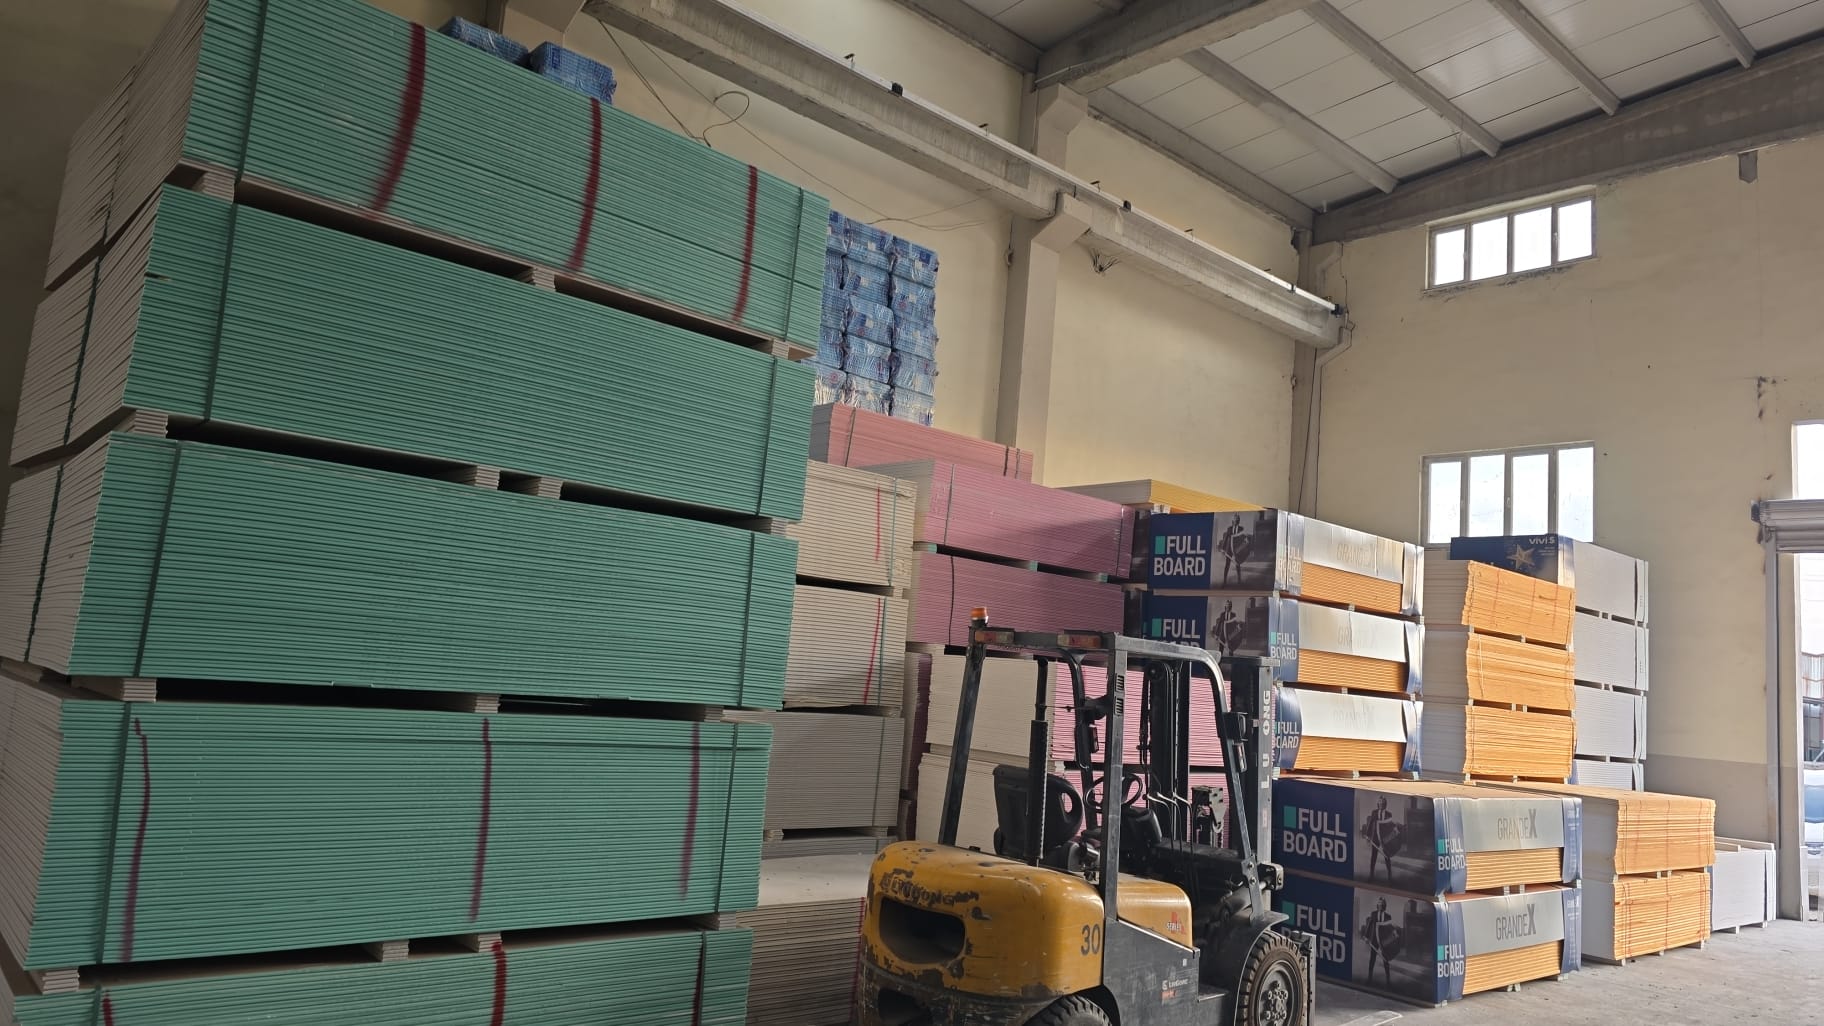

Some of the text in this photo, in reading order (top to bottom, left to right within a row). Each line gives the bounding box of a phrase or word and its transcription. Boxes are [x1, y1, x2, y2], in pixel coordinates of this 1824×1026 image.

[1166, 535, 1206, 555] FULL
[1153, 557, 1206, 576] BOARD
[1163, 618, 1201, 639] FULL
[1276, 632, 1297, 646] FULL
[1270, 646, 1297, 660] BOARD
[1278, 721, 1300, 734] FULL
[1276, 735, 1299, 749] OARD
[1298, 807, 1348, 838] FULL
[1283, 830, 1347, 863] BOARD
[1445, 838, 1464, 854] FULL
[1438, 854, 1465, 871] BOARD
[1296, 903, 1346, 938] FULL
[1495, 903, 1537, 941] GRANDEX
[1081, 923, 1100, 956] 30
[1444, 943, 1464, 960] FULL
[1437, 961, 1464, 978] BOARD
